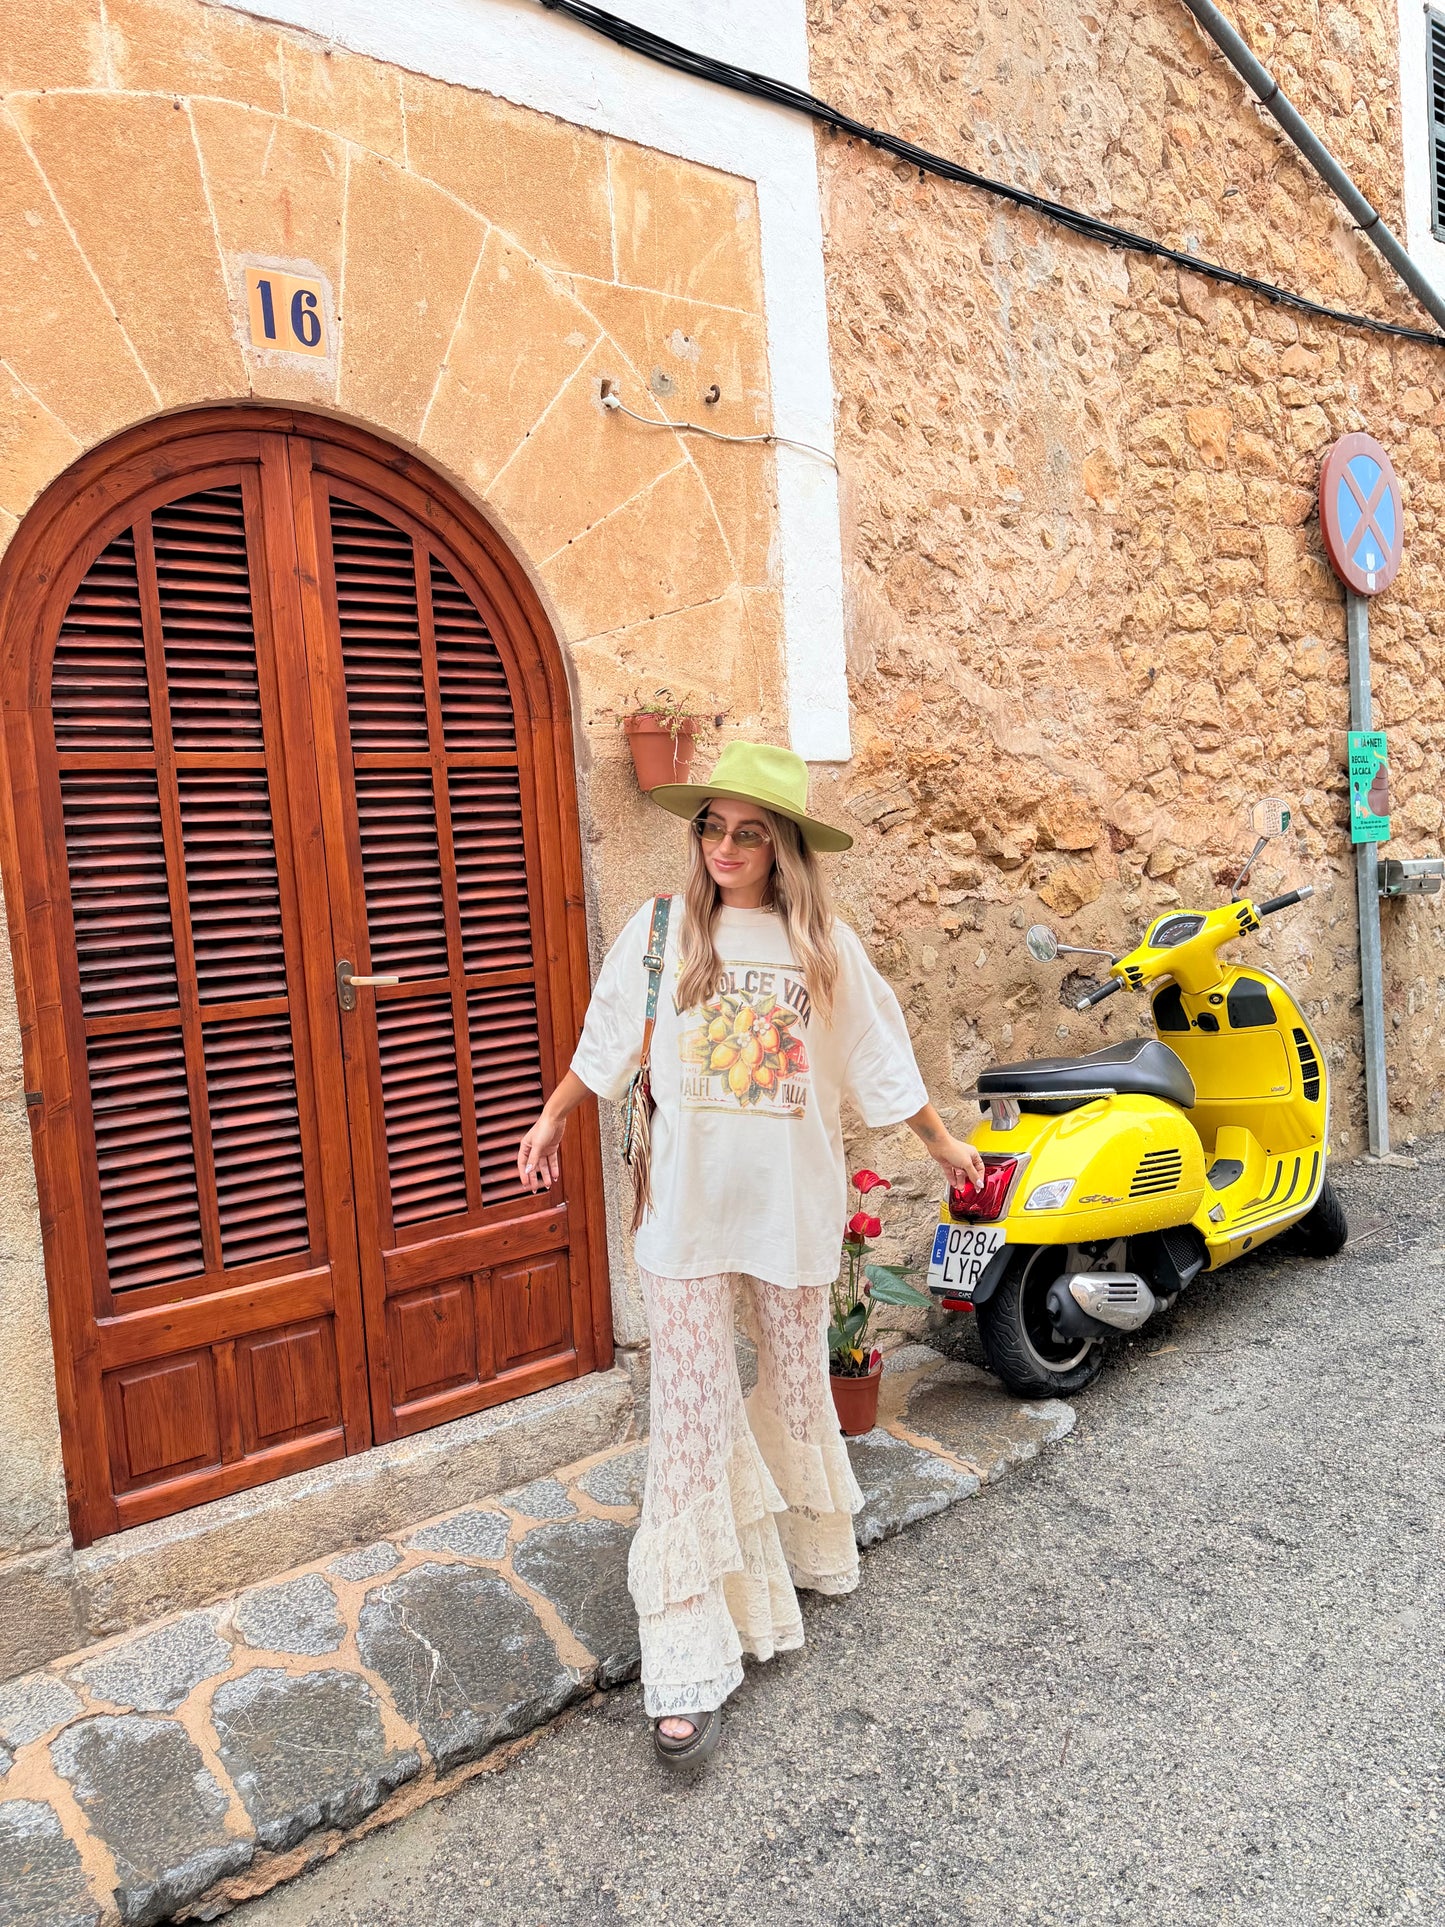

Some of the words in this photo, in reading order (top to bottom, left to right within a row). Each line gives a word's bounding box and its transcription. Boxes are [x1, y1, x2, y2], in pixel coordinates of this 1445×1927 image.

[256, 280, 321, 347] 16
[1352, 755, 1368, 763] RECULL
[936, 1249, 942, 1258] E
[948, 1229, 998, 1256] 0284
[943, 1256, 982, 1285] LYR
